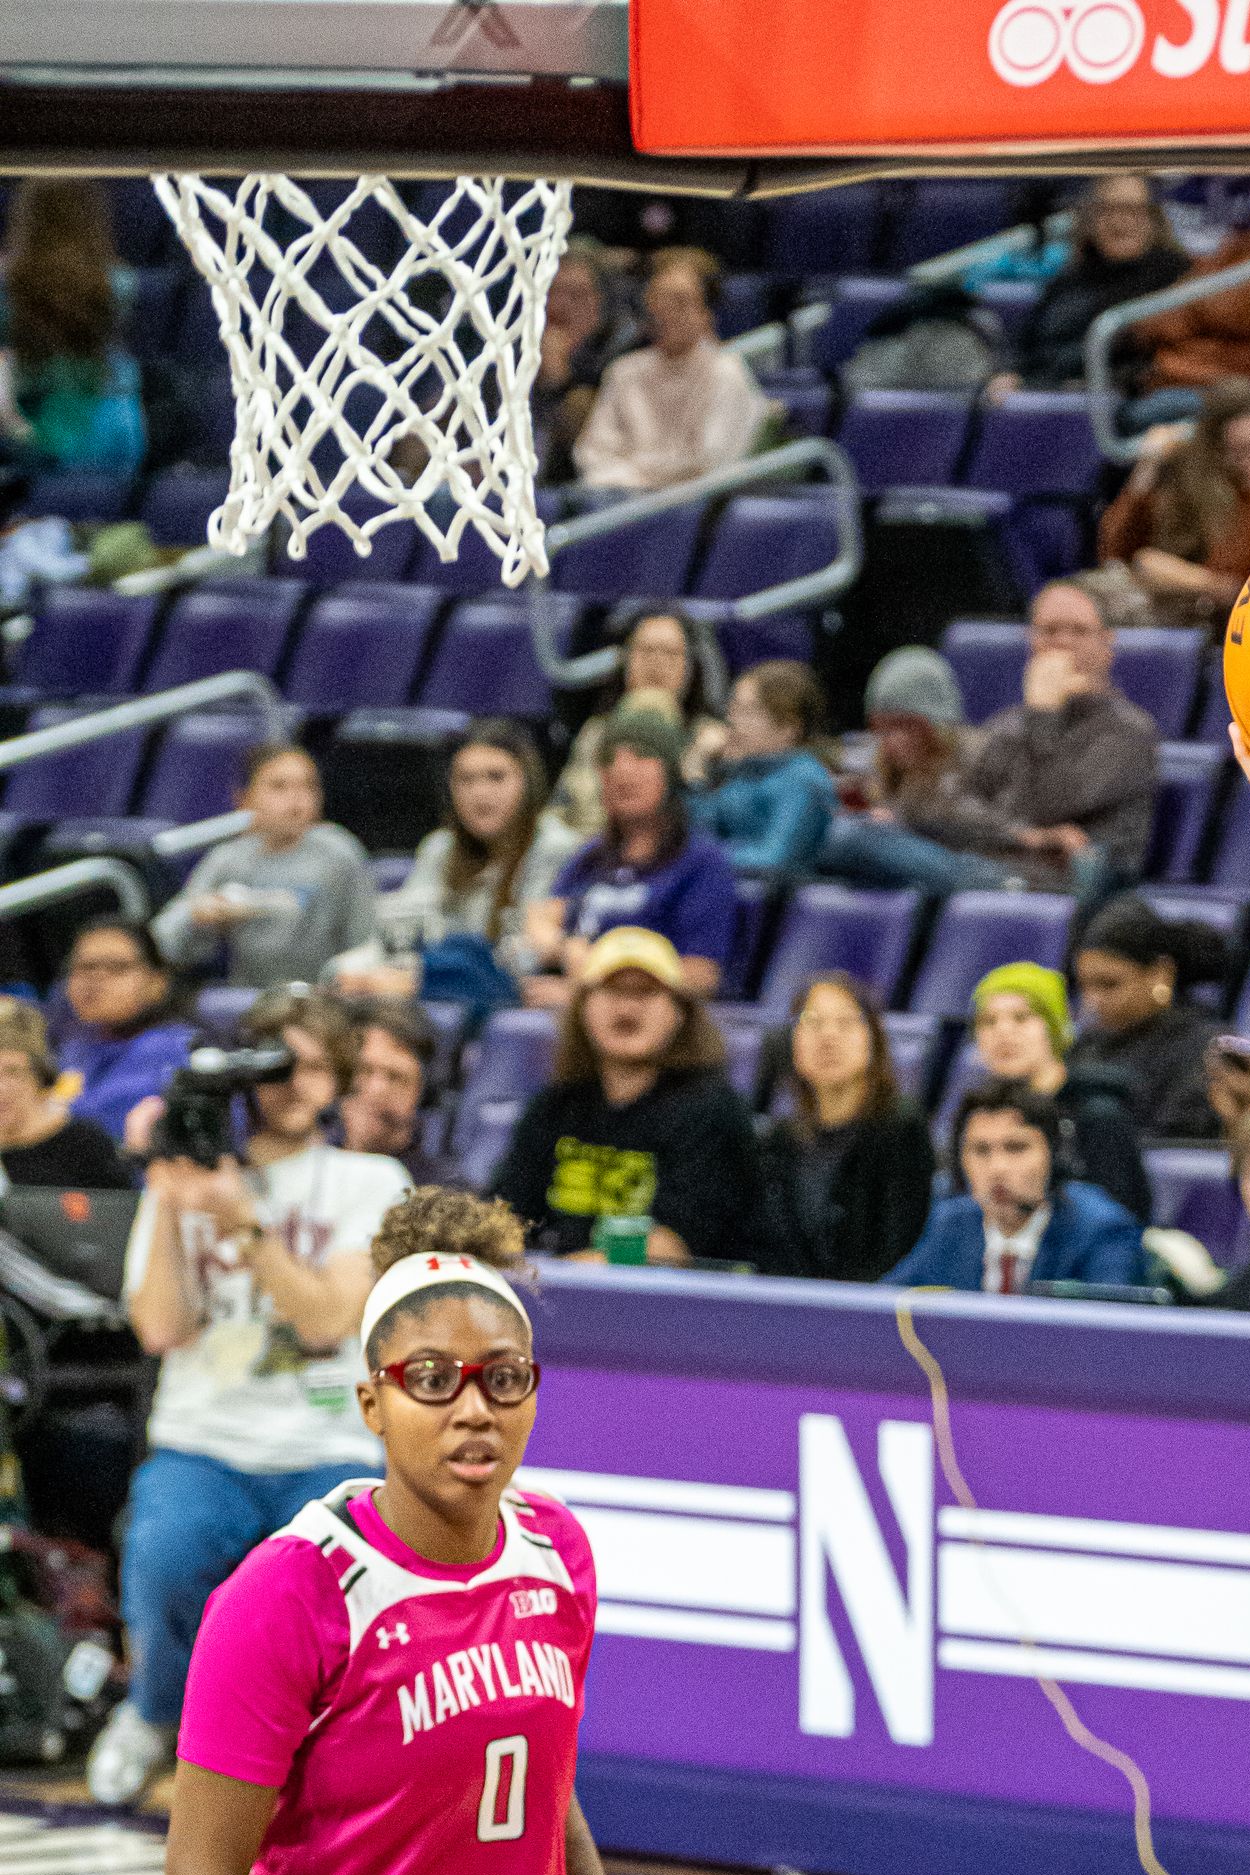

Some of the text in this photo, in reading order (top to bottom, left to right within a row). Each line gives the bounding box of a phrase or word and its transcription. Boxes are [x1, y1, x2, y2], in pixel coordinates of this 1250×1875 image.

[799, 1411, 934, 1747] N
[397, 1640, 576, 1746] MARYLAND
[476, 1733, 529, 1843] 0
